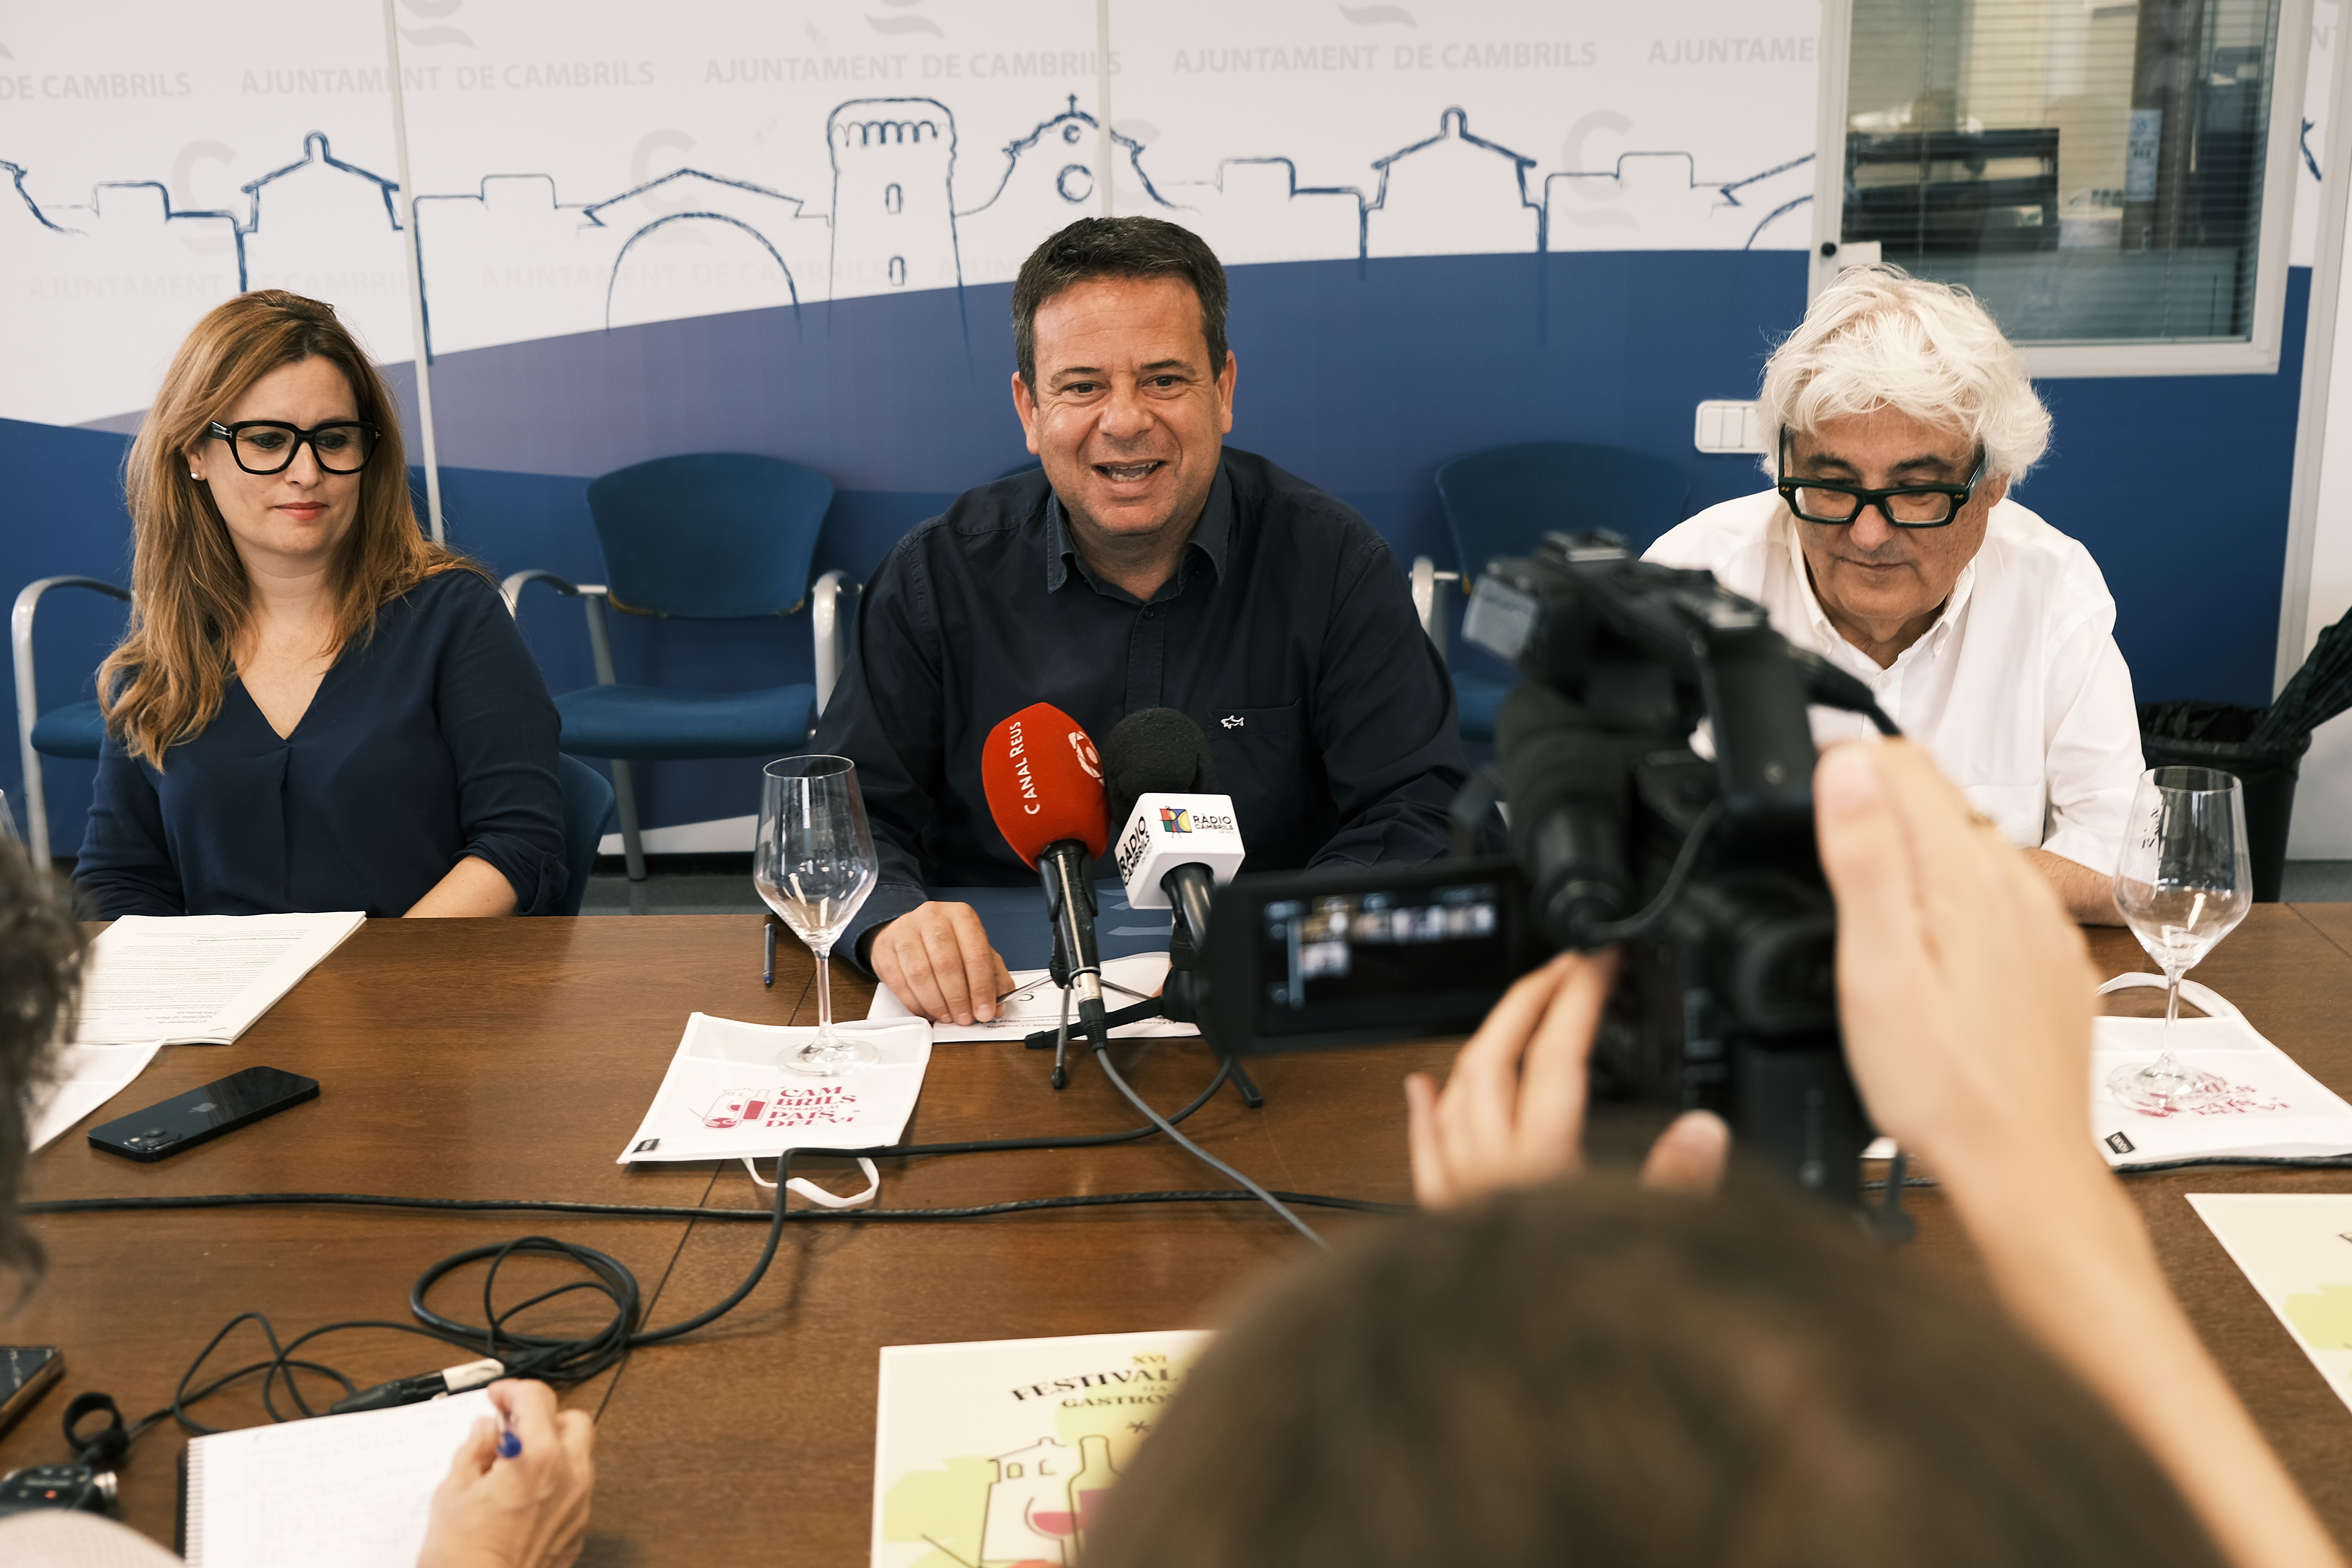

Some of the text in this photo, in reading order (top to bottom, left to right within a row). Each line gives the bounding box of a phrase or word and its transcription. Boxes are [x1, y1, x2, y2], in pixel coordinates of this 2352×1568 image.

[1172, 40, 1597, 74] AJUNTAMENT DE CAMBRILS
[1647, 37, 1820, 65] AJUNTAME
[240, 60, 655, 95] AJUNTAMNT DE CAMBRILS
[704, 55, 908, 83] AJUNTAMENT
[922, 54, 961, 79] DE
[41, 71, 192, 100] CAMBRILS
[1009, 721, 1041, 815] CANAL REUS
[776, 1095, 857, 1106] BRILS
[780, 1086, 843, 1097] CAM
[1011, 1369, 1177, 1401] FESTIVAL
